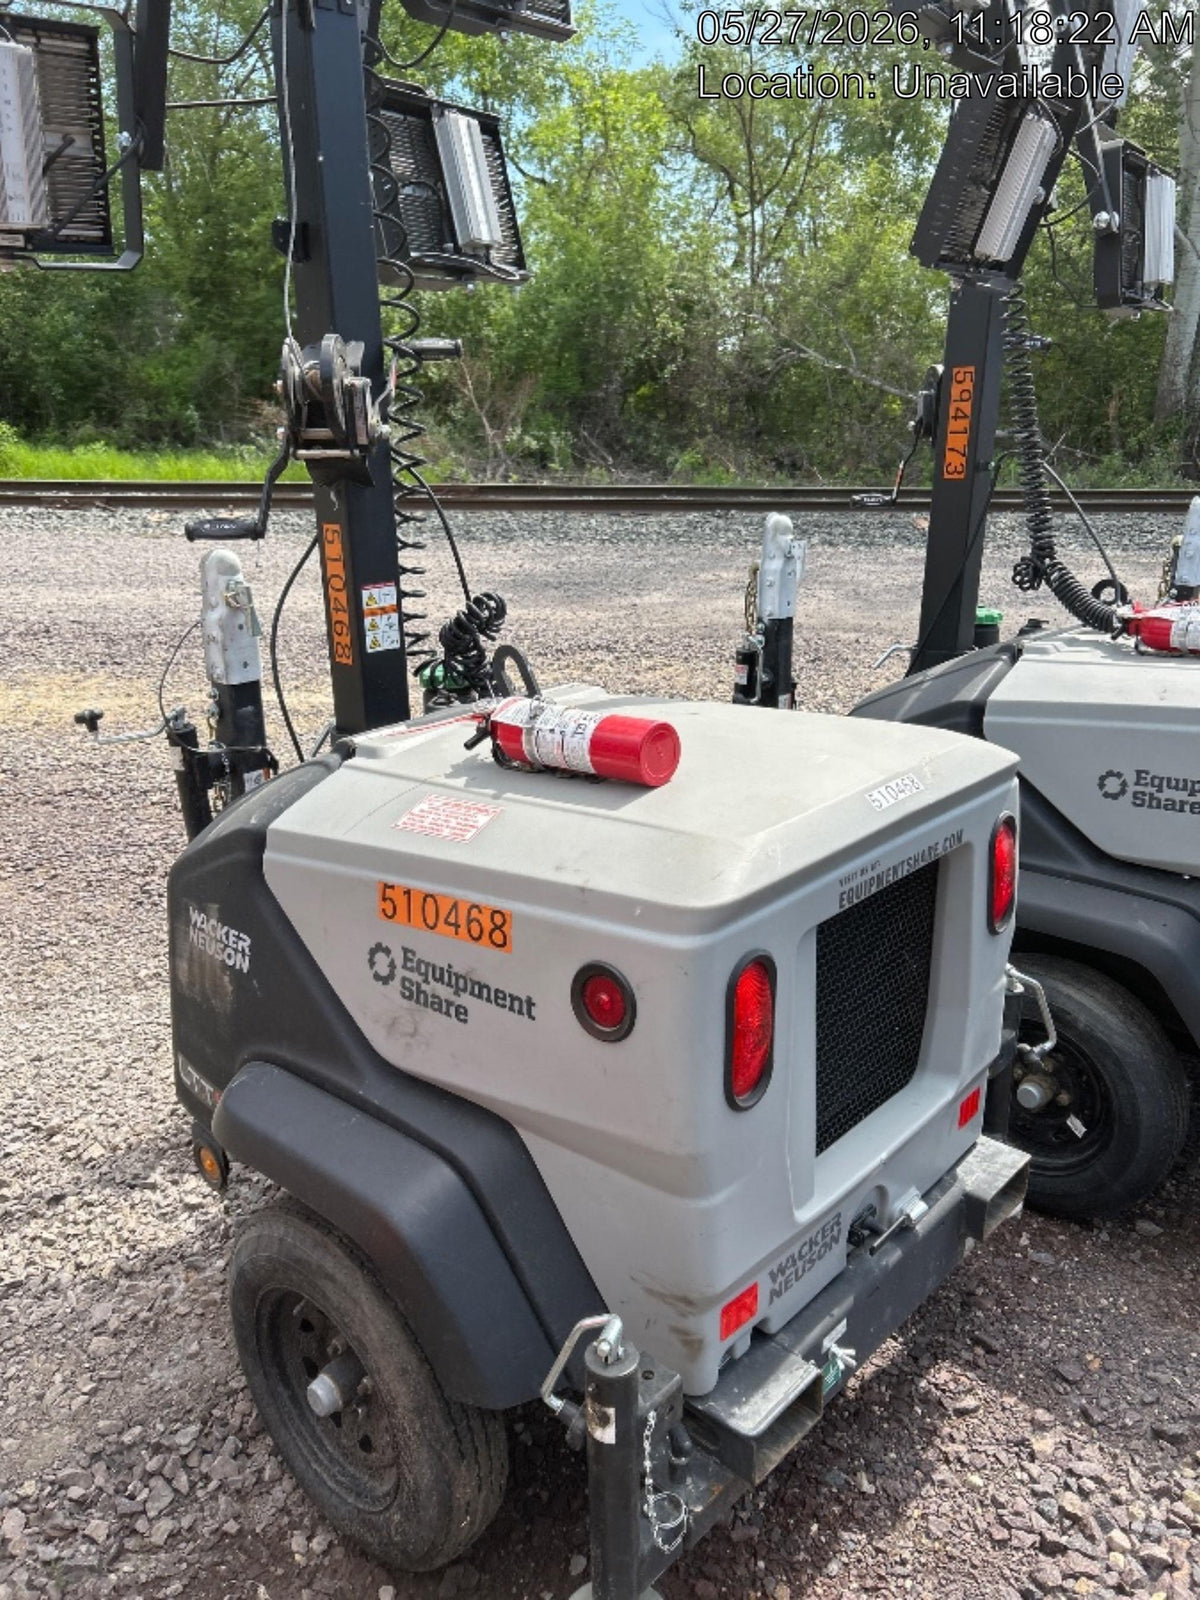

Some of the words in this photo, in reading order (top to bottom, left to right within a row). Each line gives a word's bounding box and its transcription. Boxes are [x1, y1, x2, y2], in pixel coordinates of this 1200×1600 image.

[945, 370, 974, 476] 594173
[324, 527, 353, 660] 510468
[868, 776, 921, 810] 510468
[1131, 790, 1200, 815] Share
[838, 828, 964, 910] EQUIPMENTSHARE.COM
[189, 905, 252, 956] WACKER
[189, 925, 250, 974] NEUSON
[381, 882, 508, 949] 510468
[399, 975, 469, 1025] Share
[400, 945, 537, 1022] Equipment
[767, 1211, 842, 1285] WACKER
[767, 1226, 842, 1308] NEUSON
